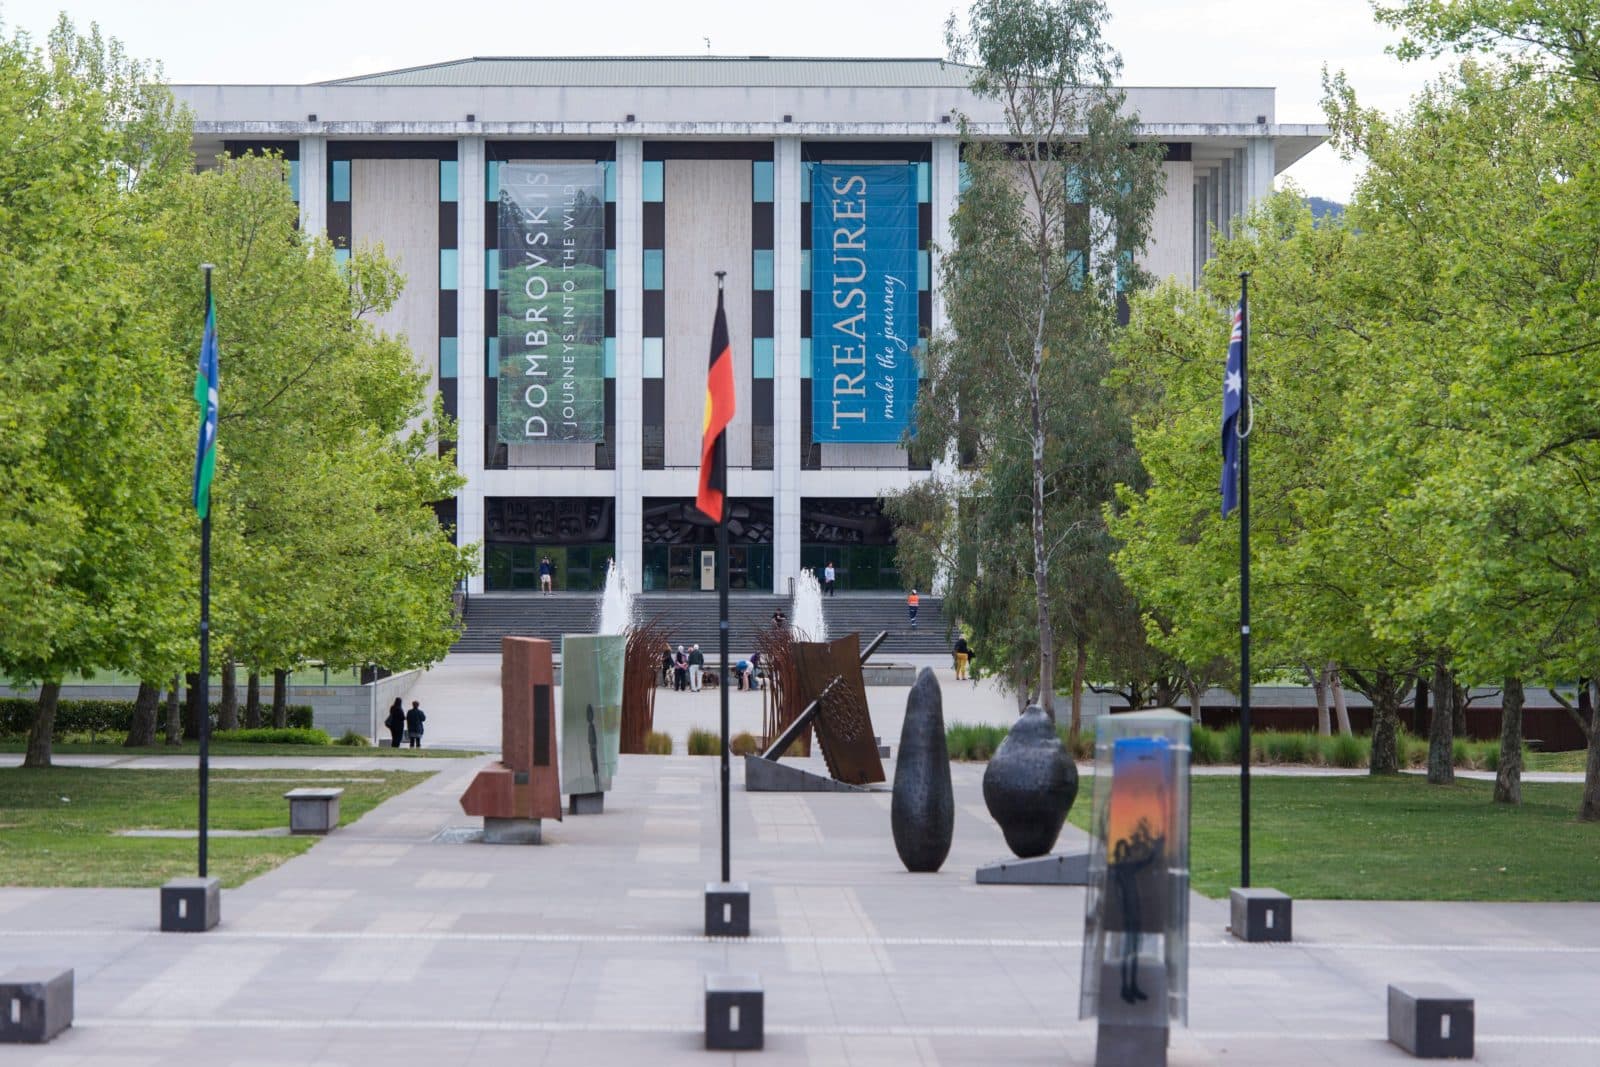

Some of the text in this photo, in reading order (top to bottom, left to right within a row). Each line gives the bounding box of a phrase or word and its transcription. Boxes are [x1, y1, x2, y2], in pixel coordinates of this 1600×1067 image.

[525, 173, 549, 437] DOMBROVSKIS
[563, 184, 578, 428] JOURNEYS INTO THE WILD
[832, 175, 867, 430] TREASURES
[875, 274, 909, 420] make the journey
